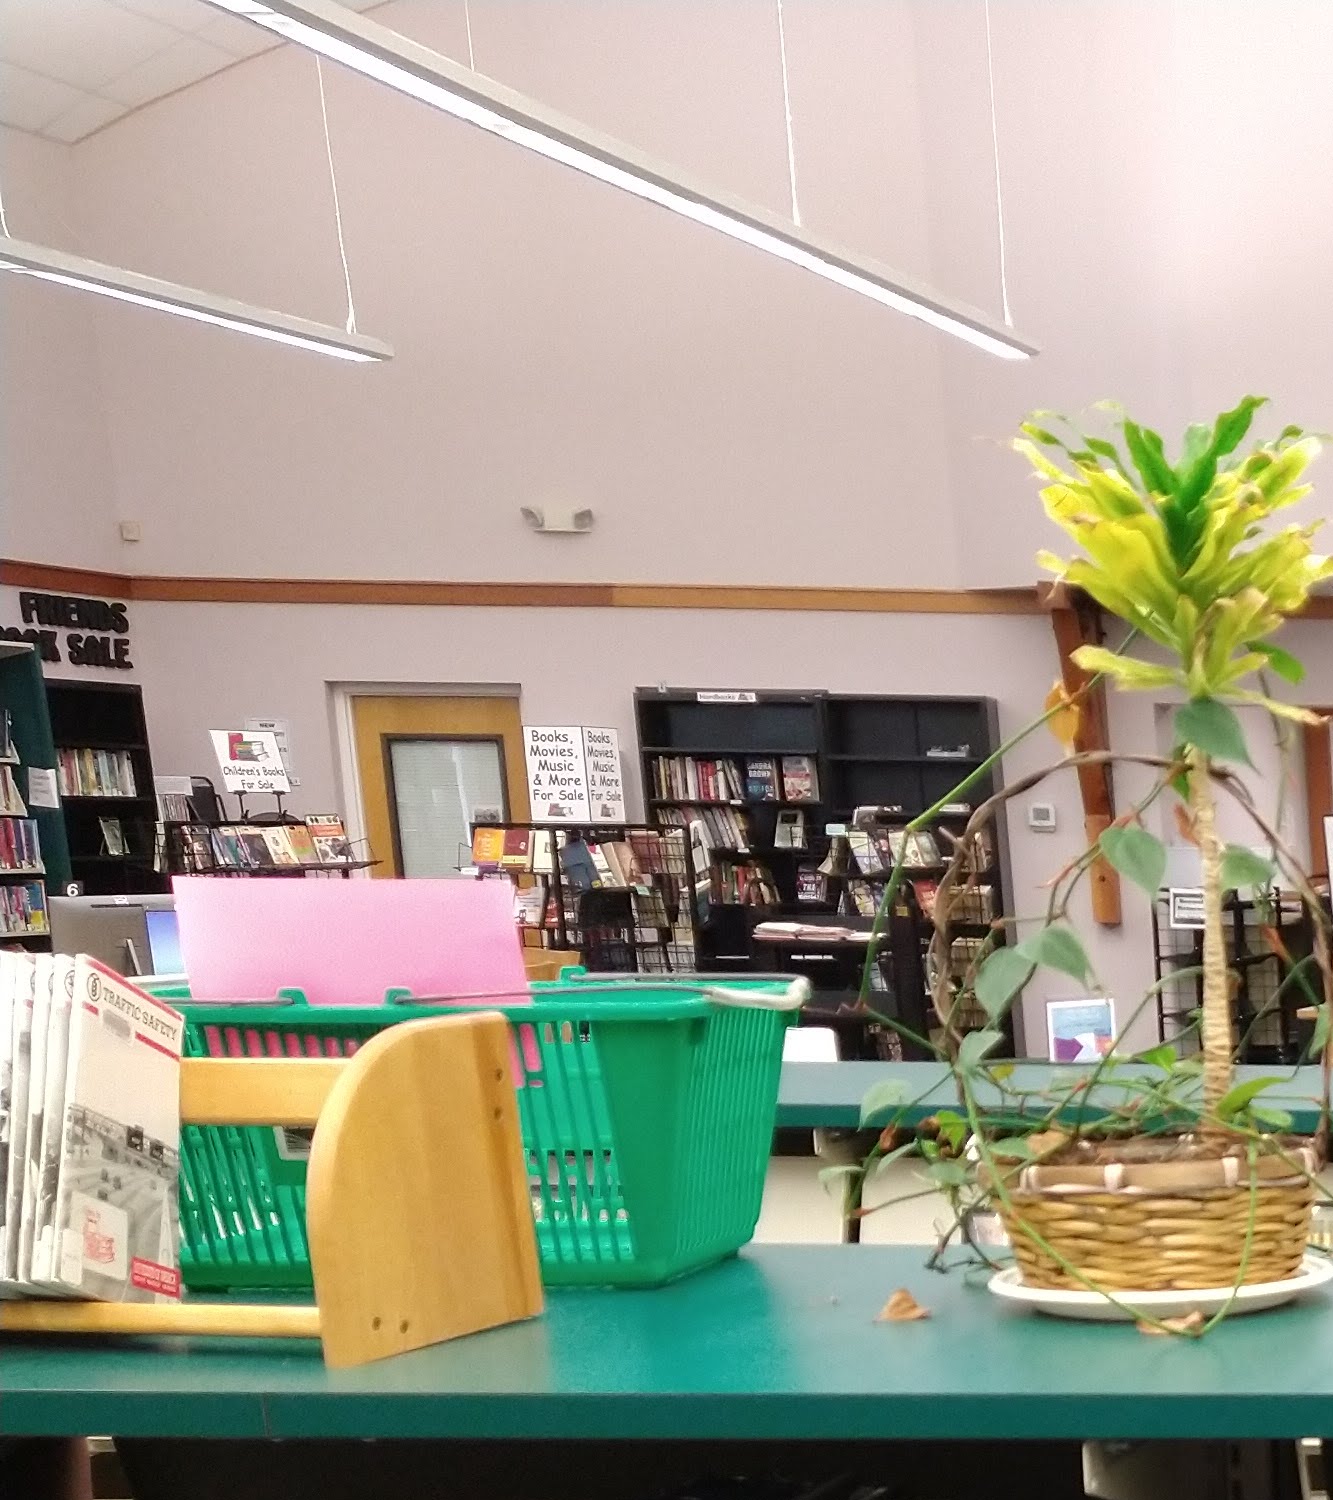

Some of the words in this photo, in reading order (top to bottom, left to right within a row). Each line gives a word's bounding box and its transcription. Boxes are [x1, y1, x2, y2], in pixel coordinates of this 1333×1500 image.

[19, 591, 129, 633] FRIENDS
[66, 633, 133, 669] SALE
[531, 730, 573, 744] Books,
[587, 730, 613, 746] Books,
[530, 744, 578, 759] Movies,
[587, 746, 617, 760] Movies,
[223, 766, 260, 776] Children's
[262, 766, 285, 776] Books
[538, 760, 574, 771] Music
[592, 761, 615, 773] Music
[241, 780, 254, 789] For
[258, 780, 274, 789] Sale
[533, 774, 542, 786] &
[549, 774, 581, 786] More
[591, 775, 597, 786] &
[600, 775, 620, 787] More
[533, 789, 553, 800] For
[559, 789, 584, 801] Sale
[591, 790, 603, 801] For
[606, 791, 622, 801] Sale
[67, 883, 79, 896] 6
[103, 987, 142, 1021] TRAFFIC
[142, 1011, 177, 1040] SAFETY
